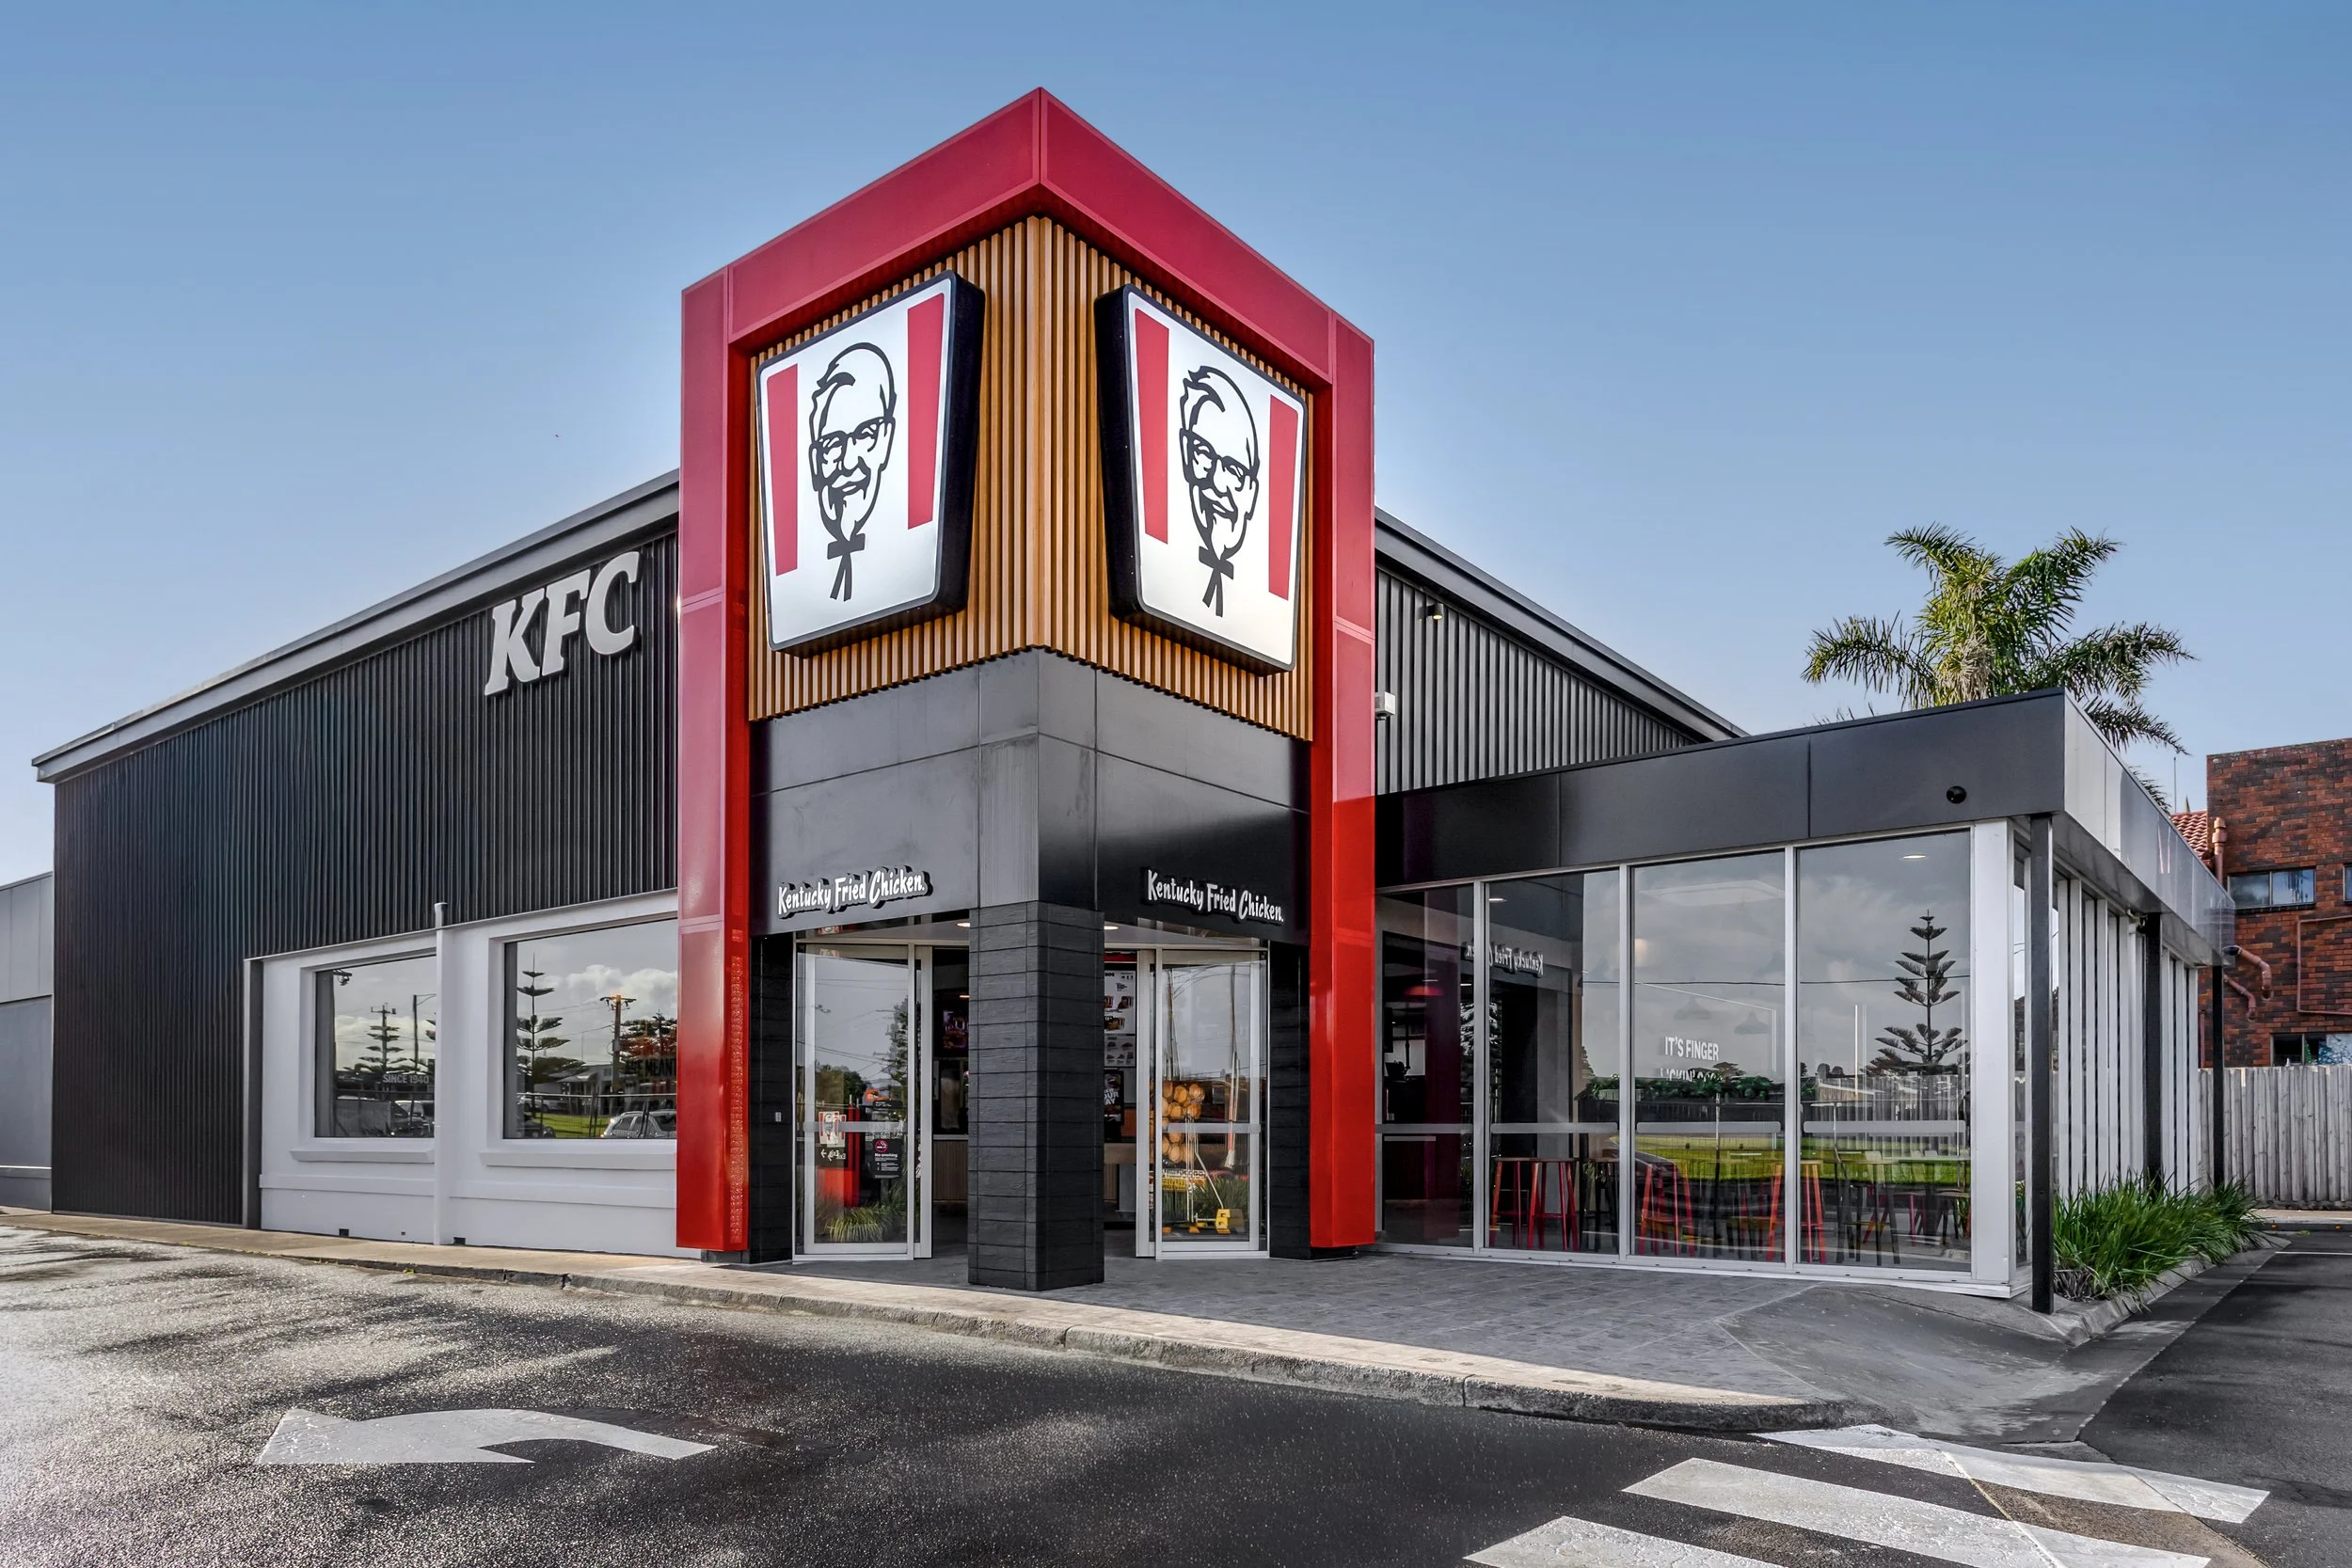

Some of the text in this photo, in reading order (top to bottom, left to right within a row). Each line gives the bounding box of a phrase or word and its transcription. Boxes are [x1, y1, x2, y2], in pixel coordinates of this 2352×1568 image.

[485, 551, 640, 696] KFC
[778, 881, 832, 915] Kentucky
[834, 874, 866, 907] Fried
[1148, 869, 1203, 911] Kentucky
[1206, 883, 1235, 912] Fried
[1665, 1036, 1719, 1062] IT'S FINGER
[383, 1073, 430, 1085] SINCE 1940
